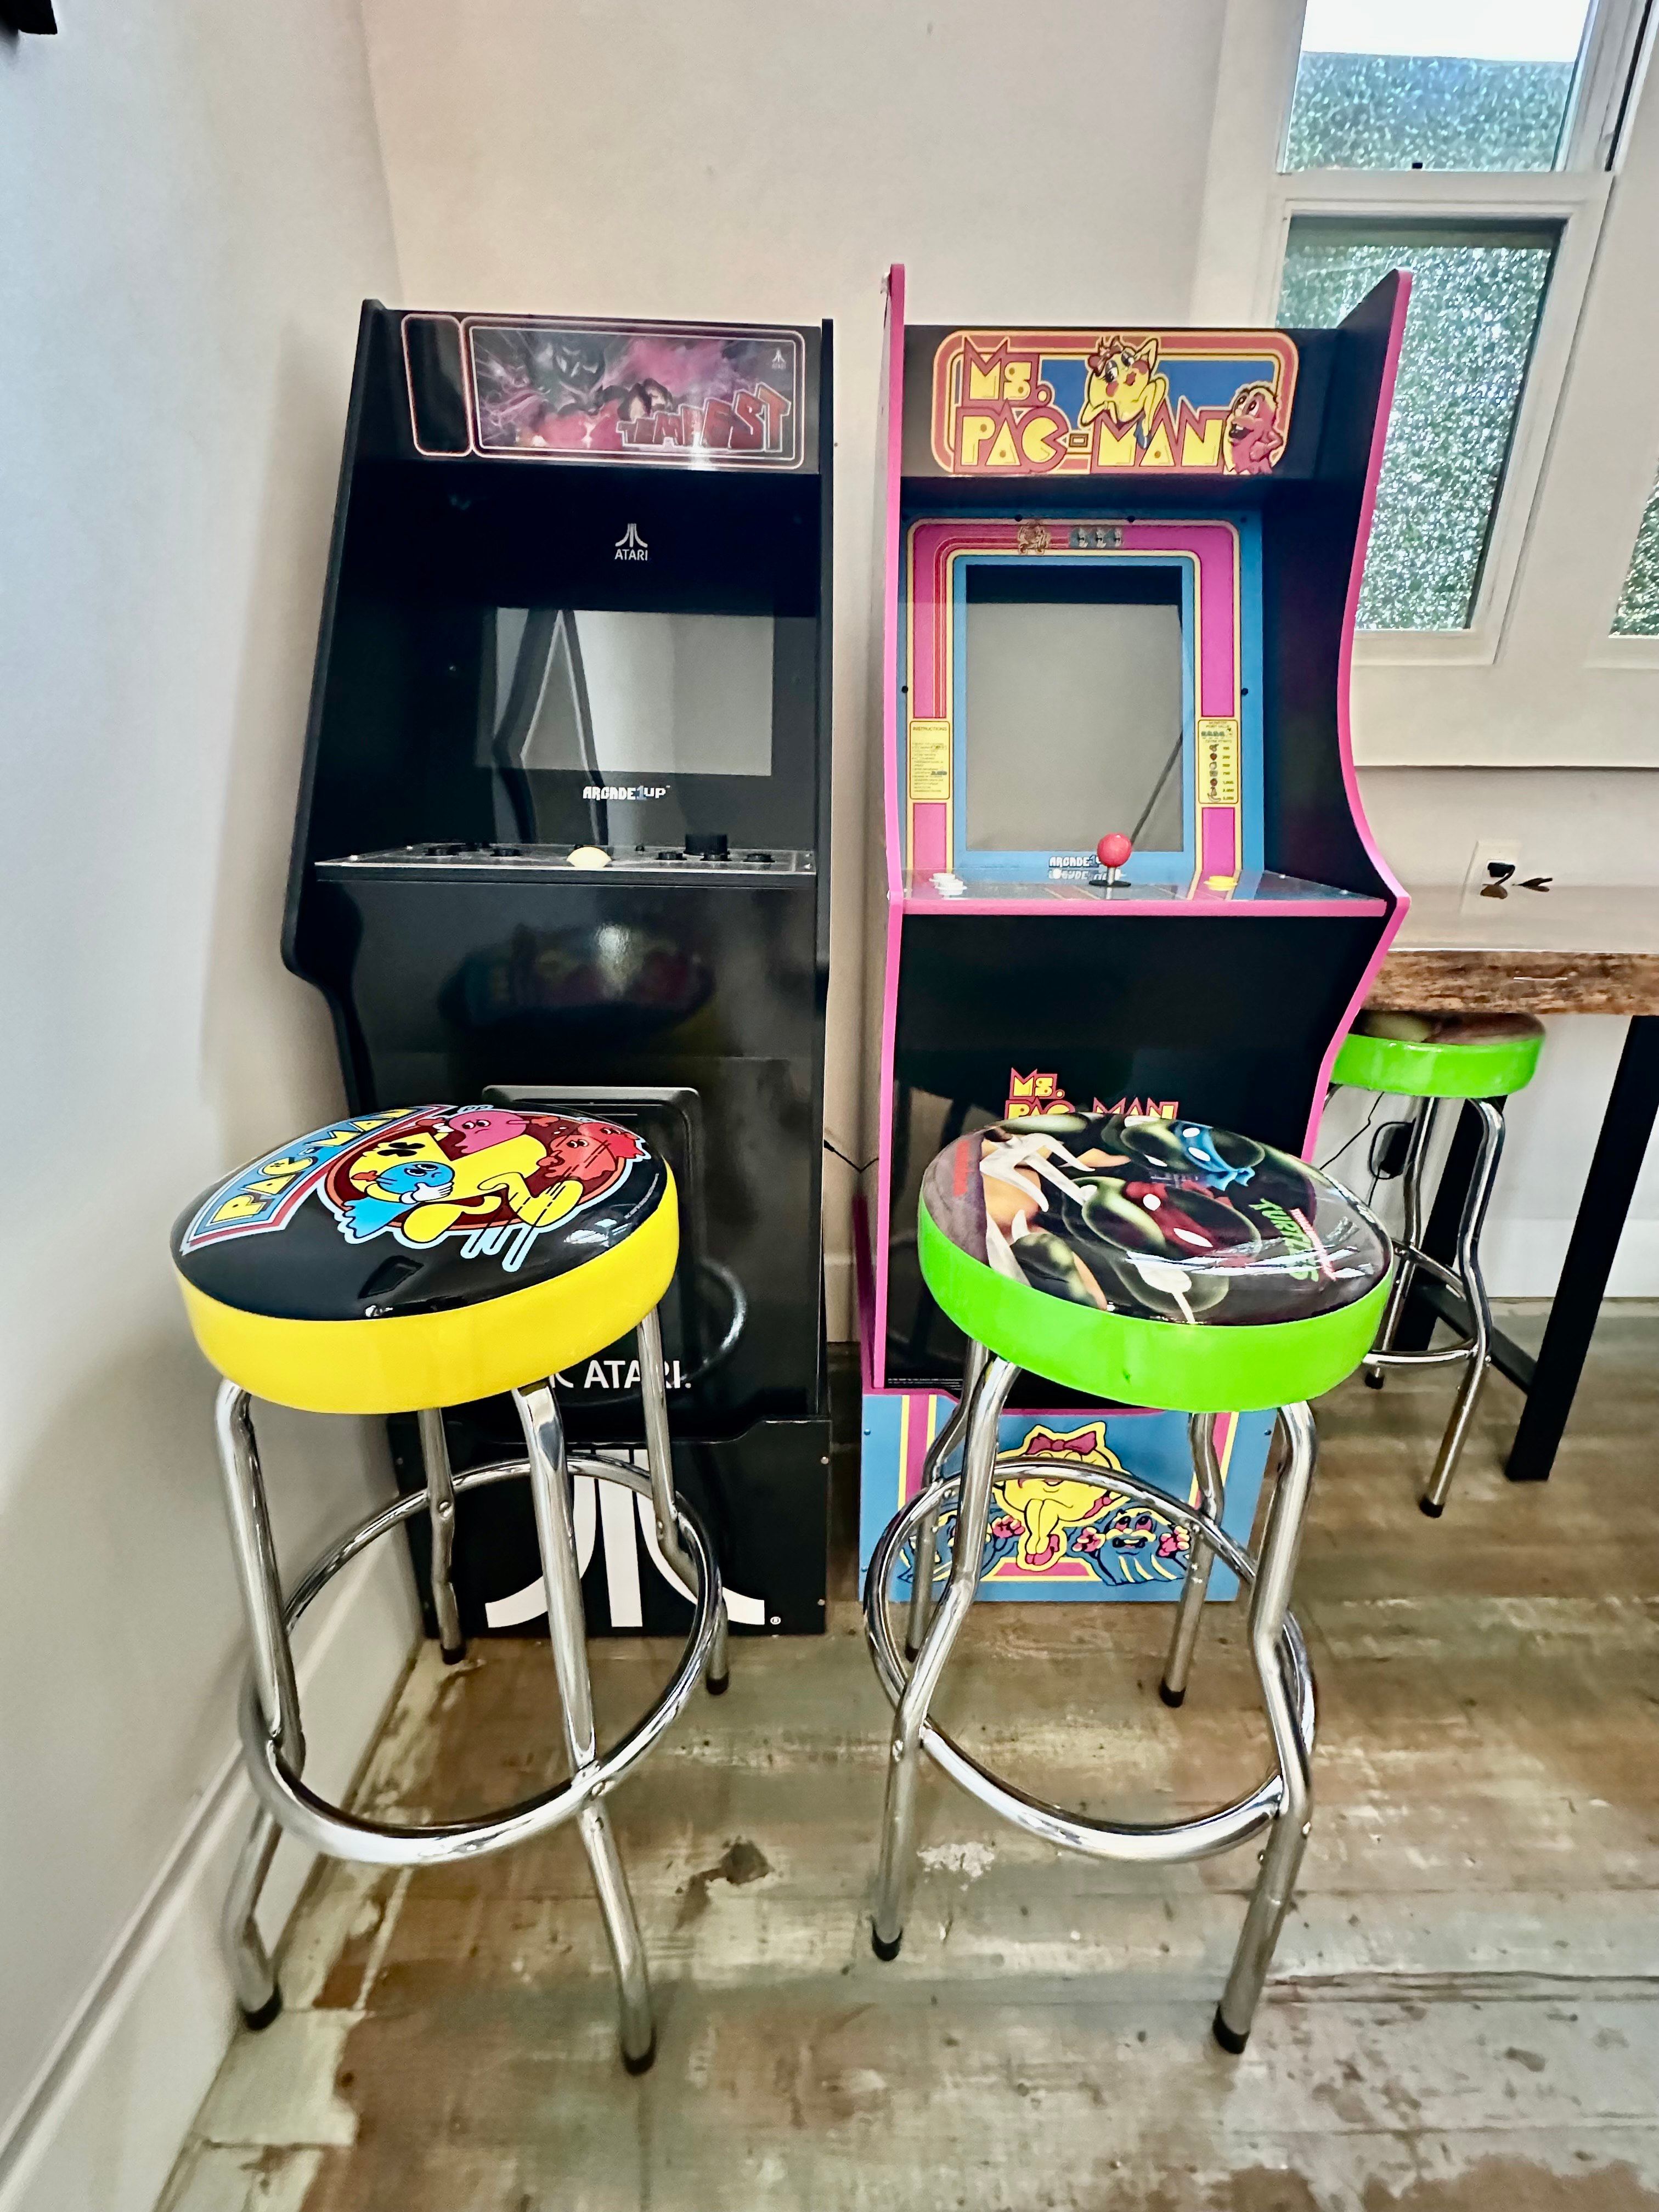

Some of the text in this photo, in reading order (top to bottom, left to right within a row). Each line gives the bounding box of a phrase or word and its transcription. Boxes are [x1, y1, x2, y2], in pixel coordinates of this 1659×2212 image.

[956, 403, 1228, 473] PAC-MAN
[614, 548, 648, 561] ATARI
[210, 1108, 418, 1226] PAC-MAN
